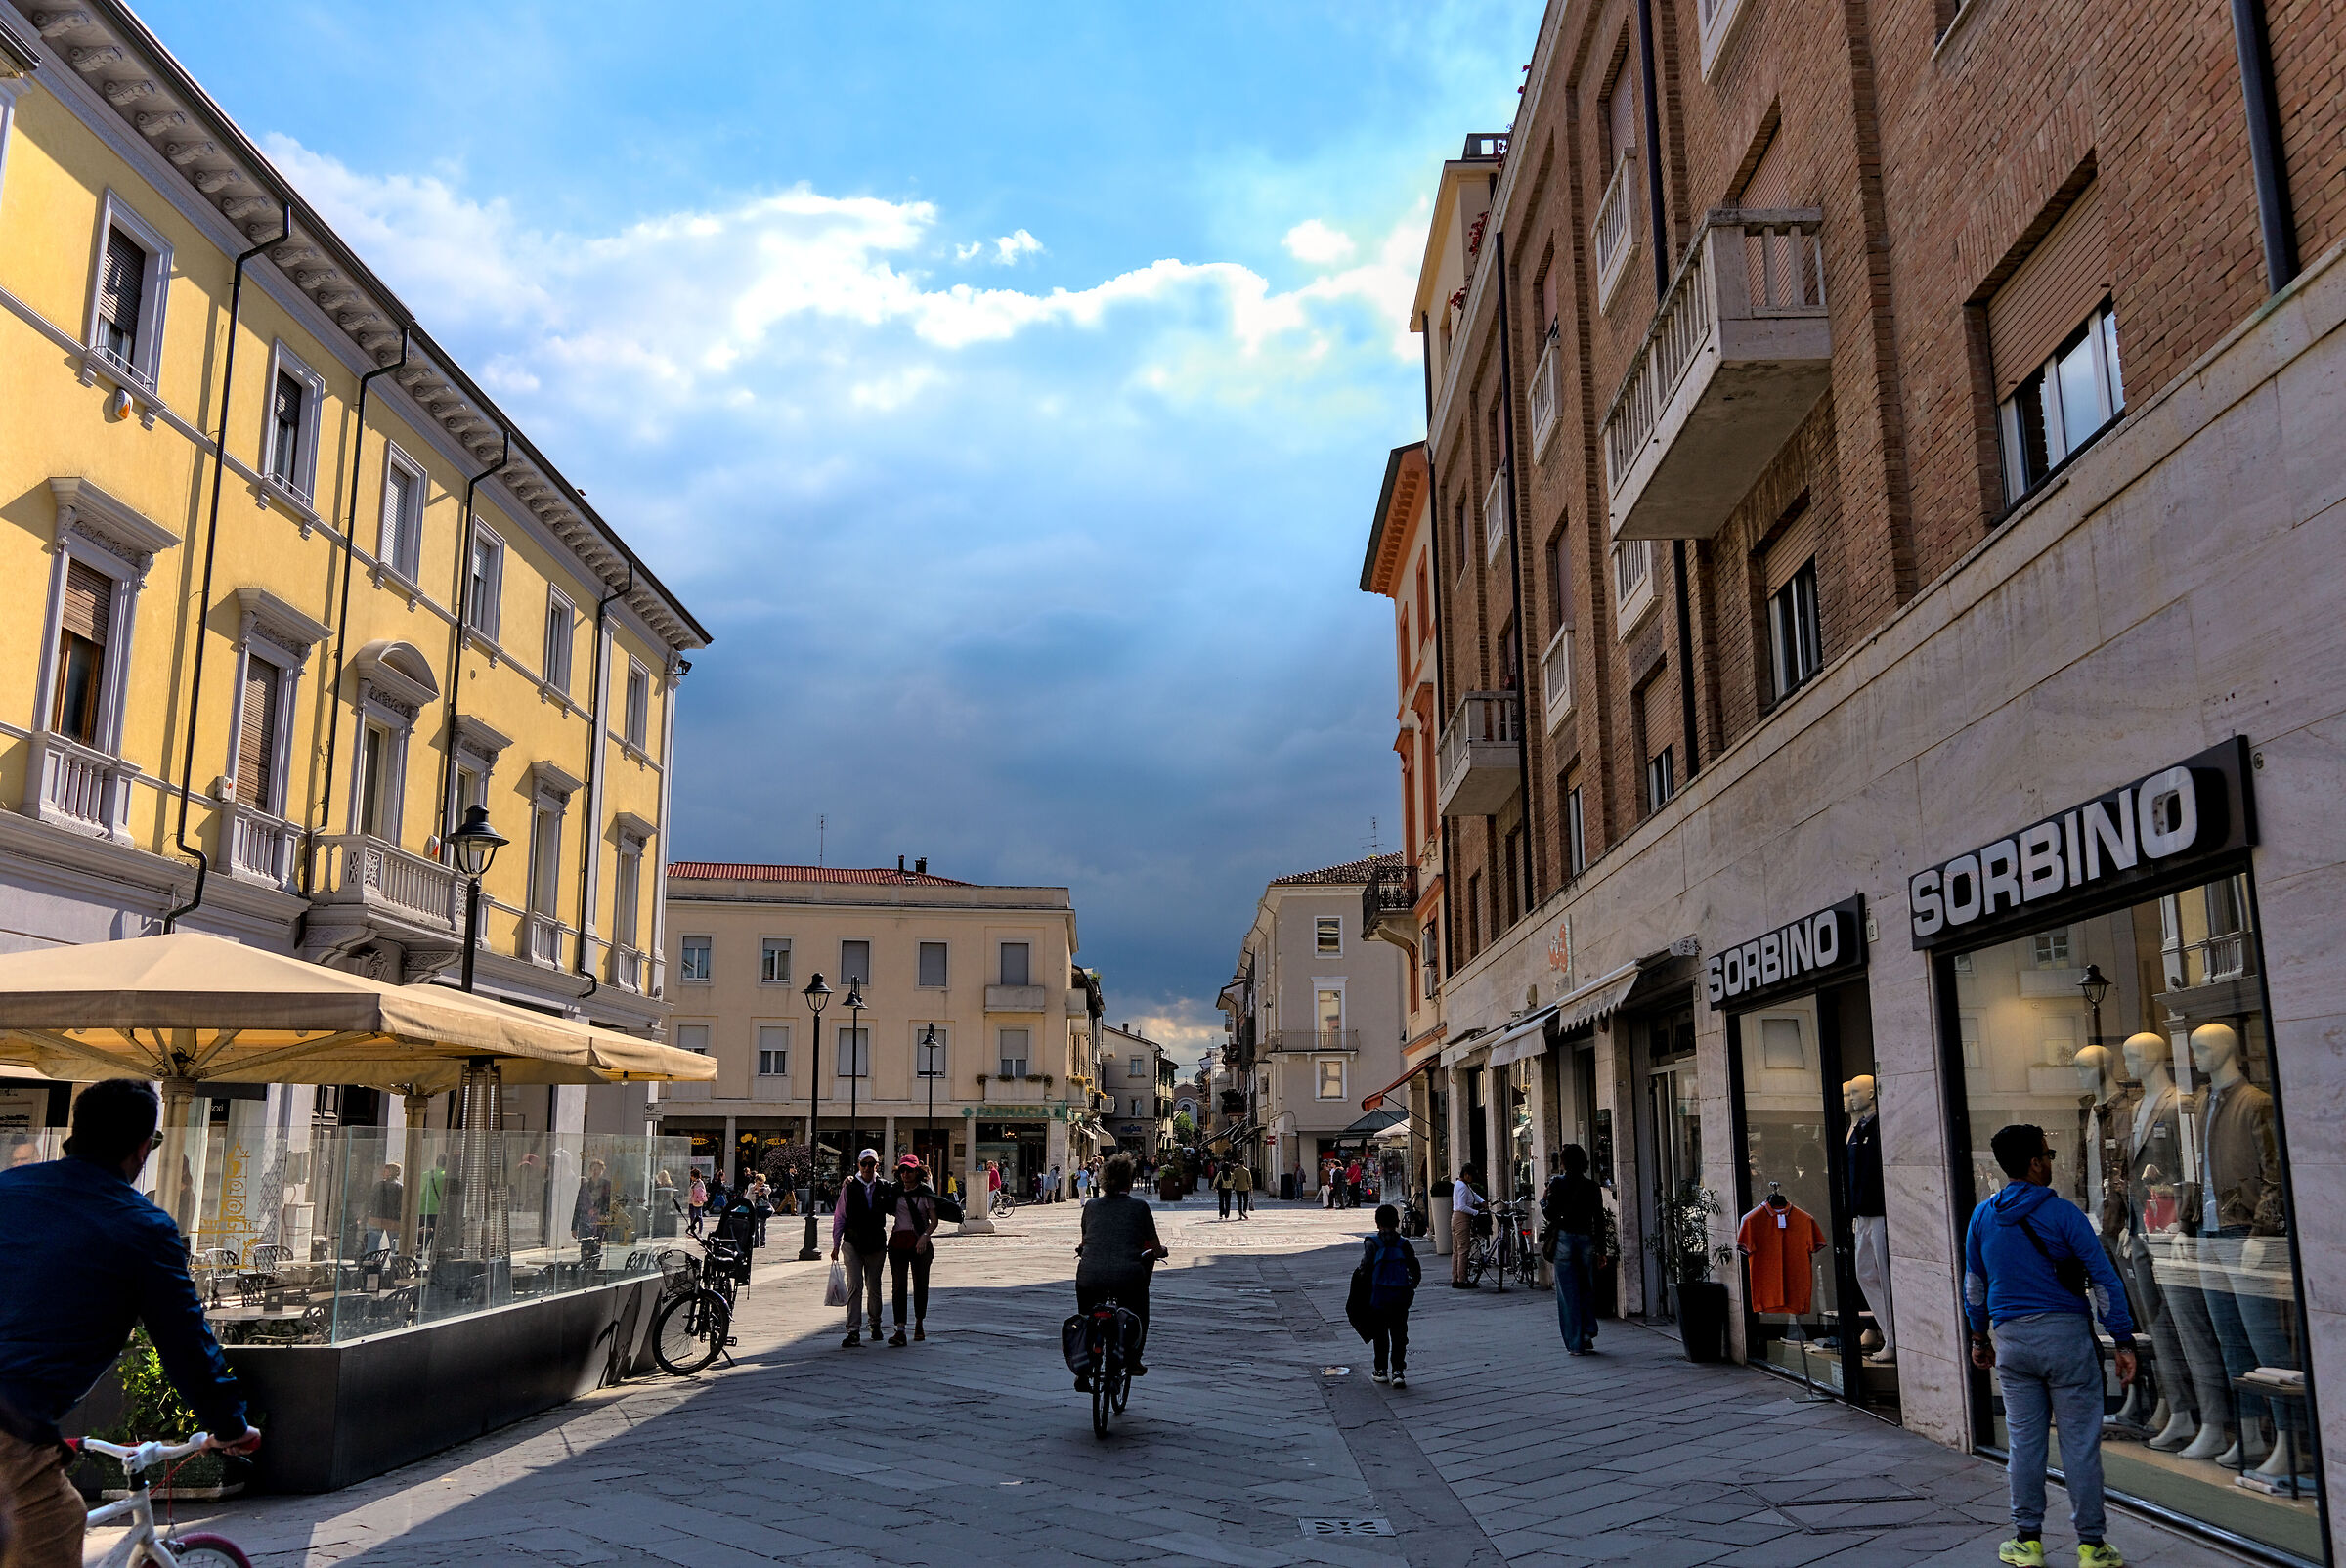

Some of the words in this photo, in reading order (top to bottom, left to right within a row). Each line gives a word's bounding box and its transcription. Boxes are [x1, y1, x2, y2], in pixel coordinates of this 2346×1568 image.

[2252, 751, 2264, 770] G
[1910, 764, 2198, 938] SORBINO
[1707, 909, 1839, 1003] SORBINO
[976, 1106, 1050, 1117] FARMACIA
